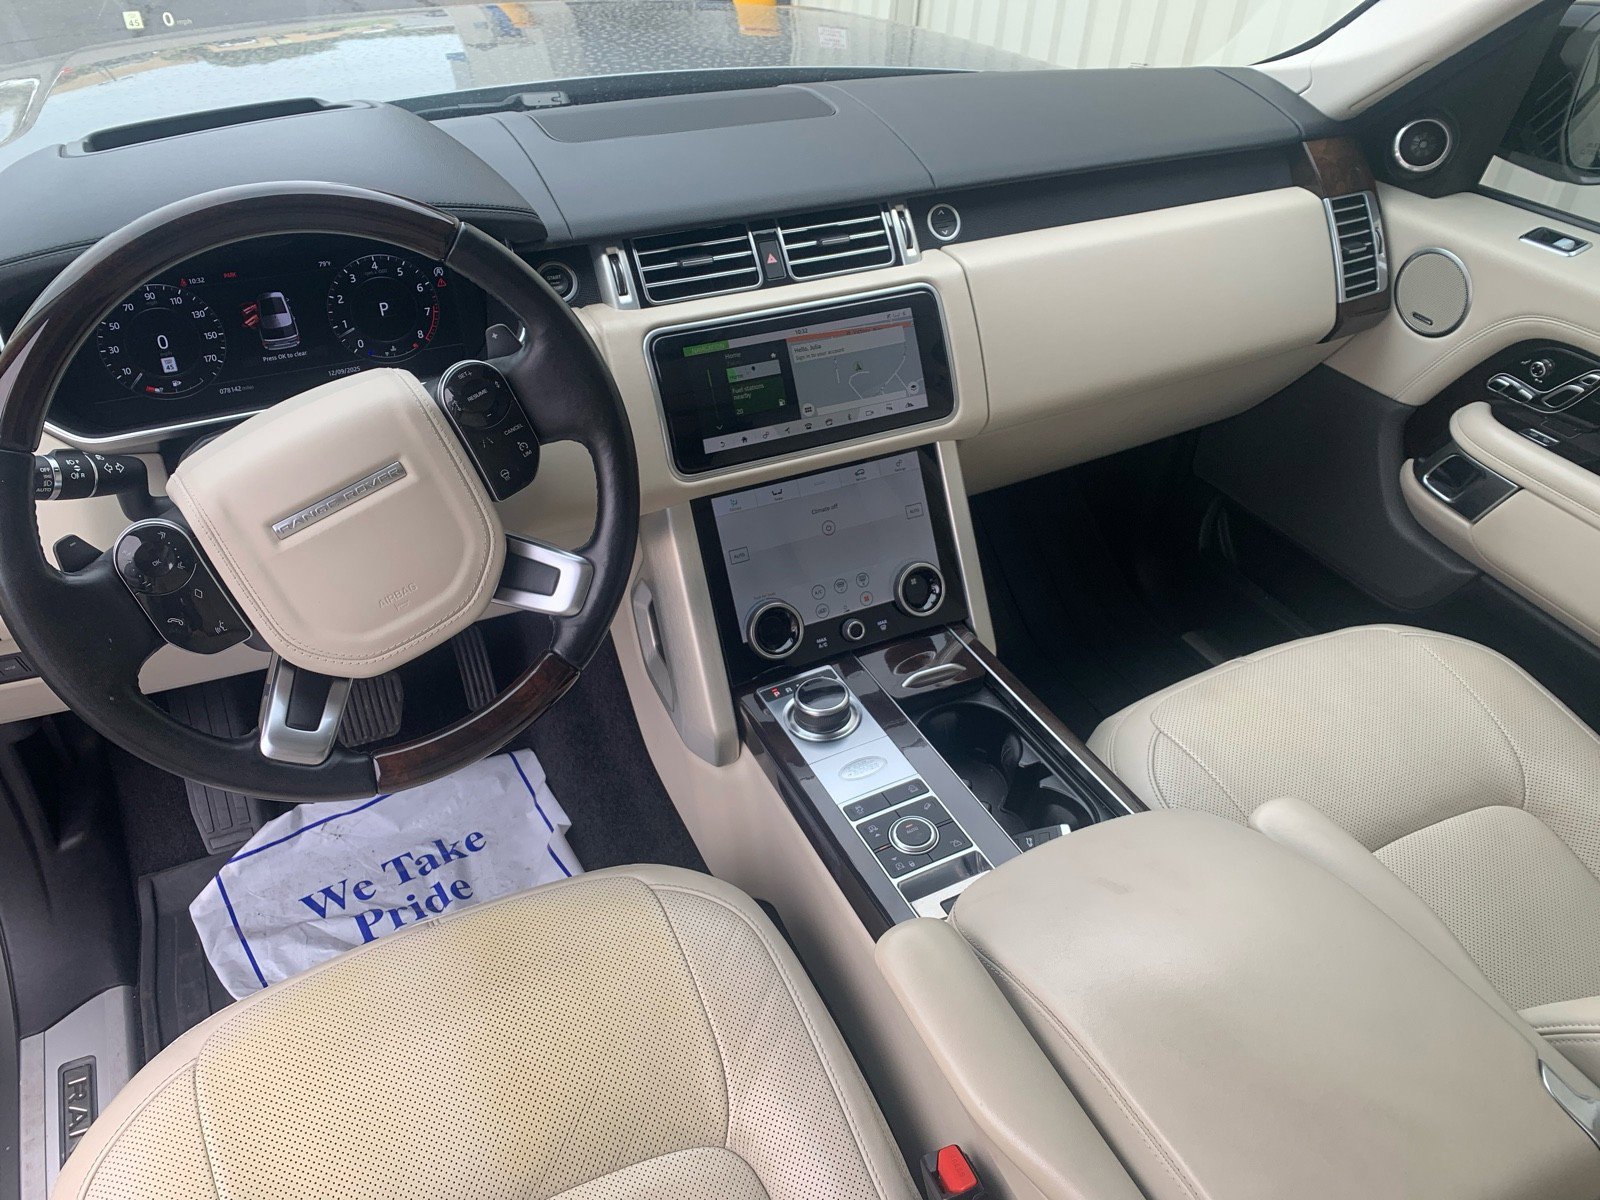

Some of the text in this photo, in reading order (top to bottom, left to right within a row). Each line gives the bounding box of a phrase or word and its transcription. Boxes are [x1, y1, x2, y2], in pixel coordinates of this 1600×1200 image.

[129, 19, 140, 27] 45
[162, 11, 174, 27] 0
[372, 262, 378, 270] 4
[397, 268, 404, 276] 5
[188, 276, 205, 284] 10:32
[350, 275, 356, 283] 3
[417, 284, 424, 292] 6
[144, 292, 155, 301] 90
[170, 296, 183, 306] 110
[337, 295, 344, 304] 2
[122, 303, 134, 312] 70
[379, 302, 389, 317] P
[424, 307, 430, 316] 7
[192, 310, 206, 319] 130
[109, 322, 120, 331] 50
[342, 320, 348, 328] 1
[204, 331, 217, 340] 150
[417, 330, 424, 339] 8
[156, 334, 169, 349] 0
[357, 340, 364, 348] 0
[108, 345, 119, 354] 30
[204, 354, 217, 362] 170
[263, 354, 277, 362] Press
[293, 350, 307, 358] clear
[724, 352, 742, 360] Home
[327, 365, 361, 376] 12/09/2025
[219, 386, 242, 395] 078142
[746, 382, 764, 391] stations
[467, 388, 488, 402] RESUME
[733, 392, 751, 401] nearby
[504, 423, 524, 436] CANCEL
[276, 467, 402, 534] RANGE ROVER
[811, 505, 830, 515] Climate
[152, 559, 161, 567] OK
[378, 582, 418, 609] AIRBAG
[298, 831, 487, 919] We Take
[354, 878, 474, 945] Pride
